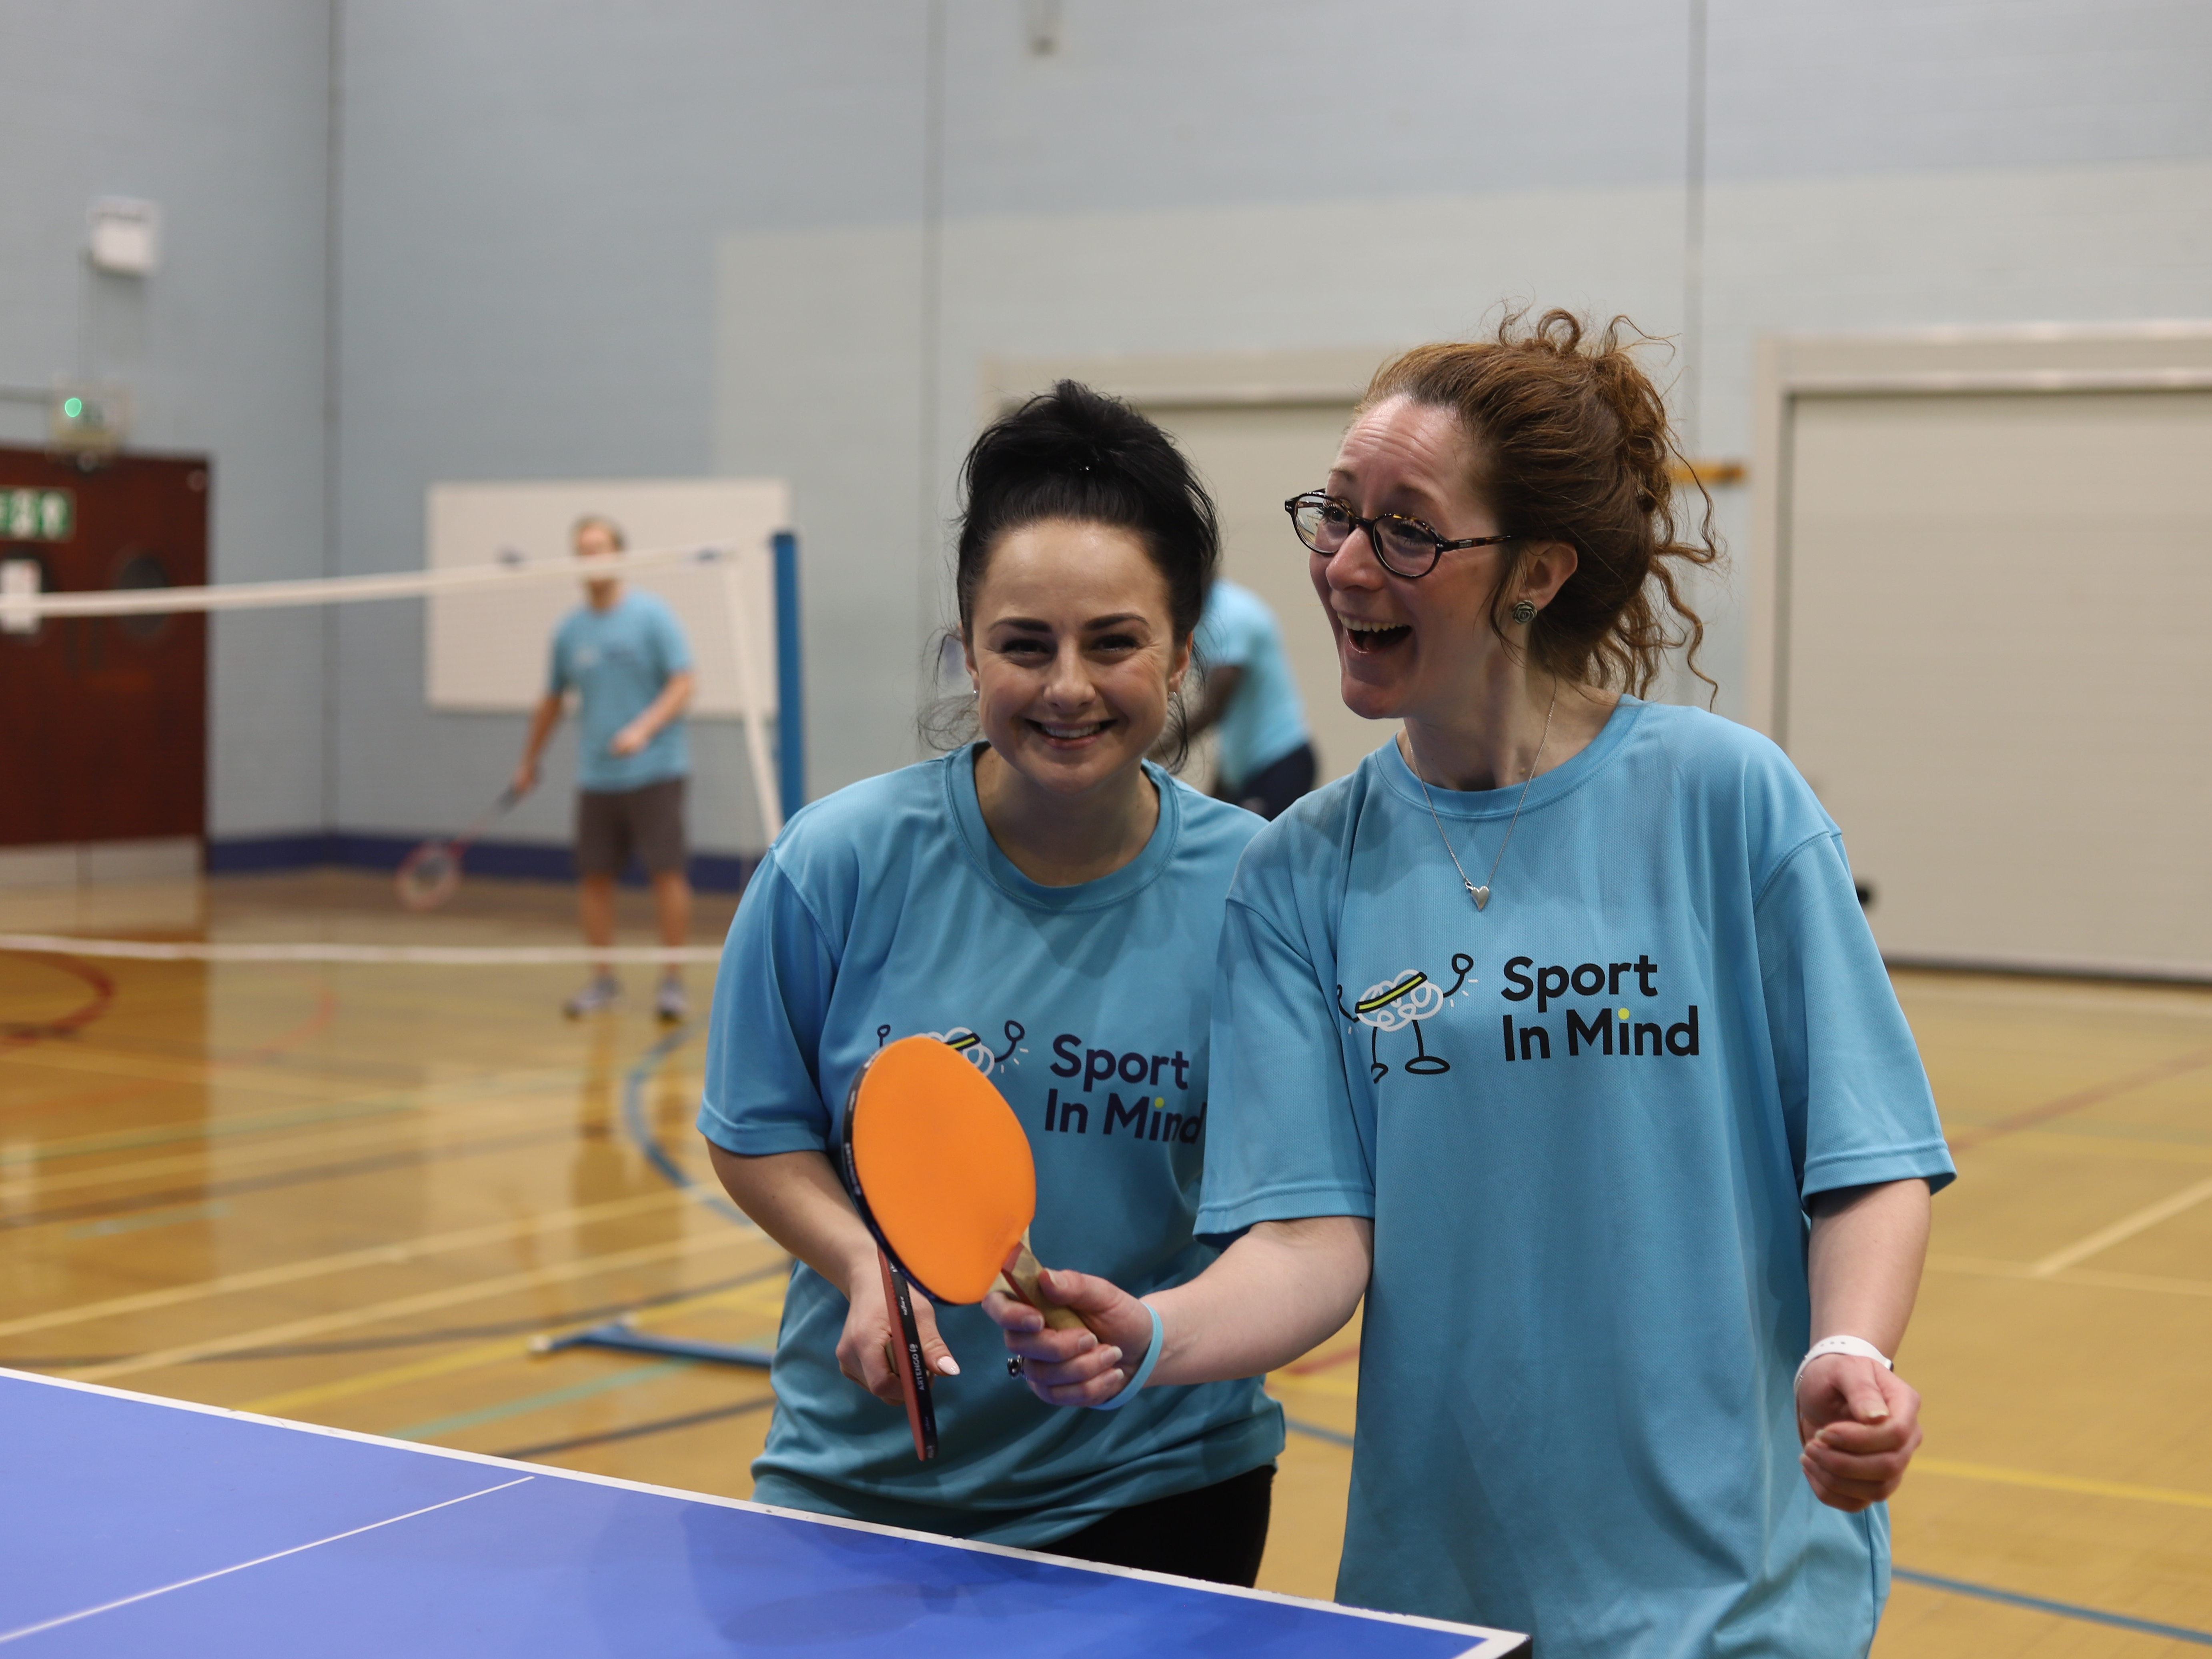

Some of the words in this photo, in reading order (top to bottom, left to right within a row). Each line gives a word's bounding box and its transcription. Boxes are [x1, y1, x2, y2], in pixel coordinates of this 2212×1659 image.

[1501, 955, 1658, 1013] Sport
[1503, 1014, 1551, 1062] In
[1566, 1005, 1699, 1057] Mind
[1050, 1034, 1189, 1093] Sport
[1045, 1088, 1089, 1134] In
[1103, 1093, 1207, 1145] Mind
